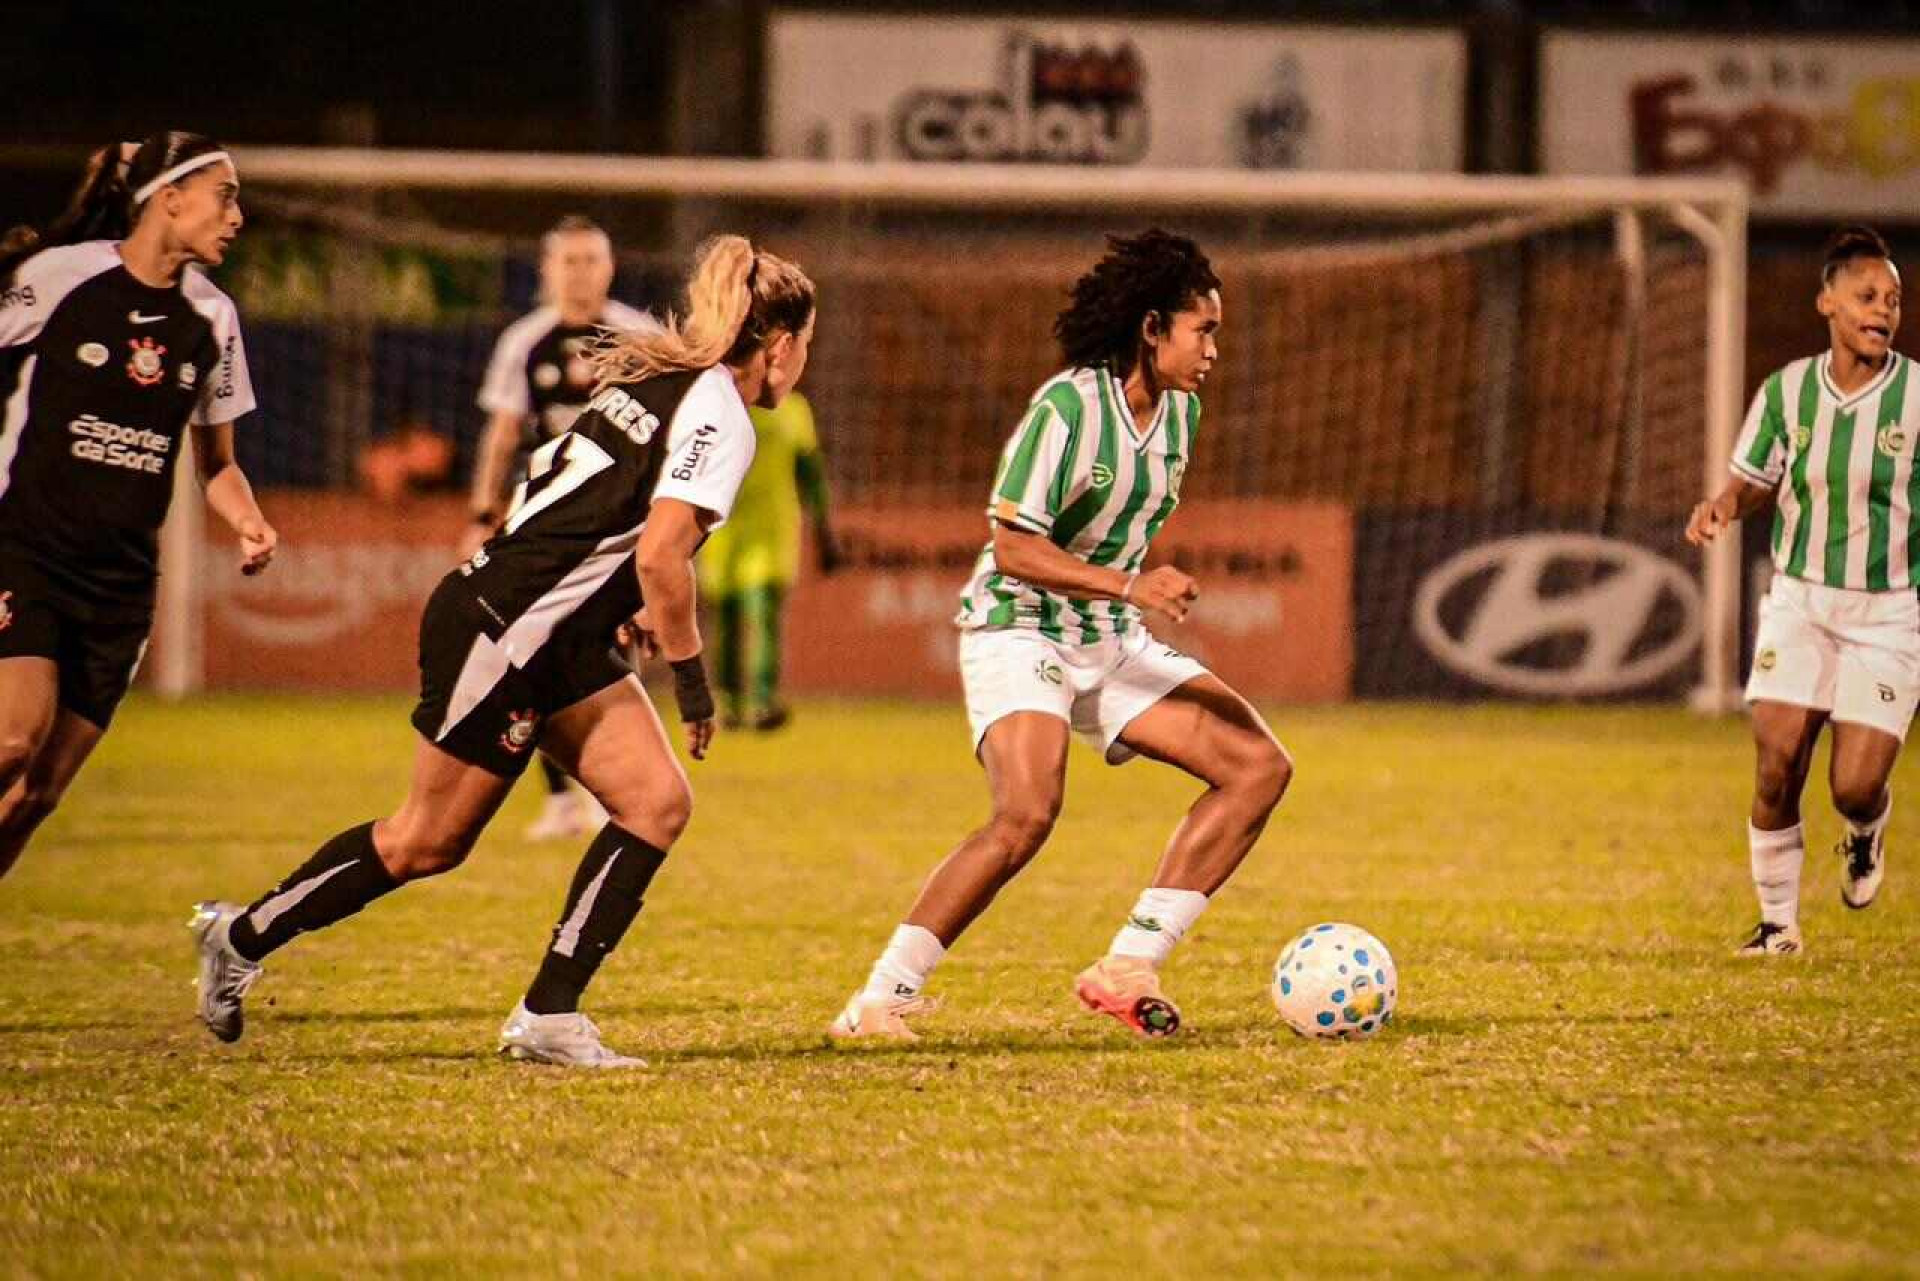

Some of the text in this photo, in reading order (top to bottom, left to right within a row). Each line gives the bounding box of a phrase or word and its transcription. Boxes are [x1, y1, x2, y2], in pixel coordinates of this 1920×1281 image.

[72, 439, 165, 474] da Sorte
[672, 439, 714, 481] bmg
